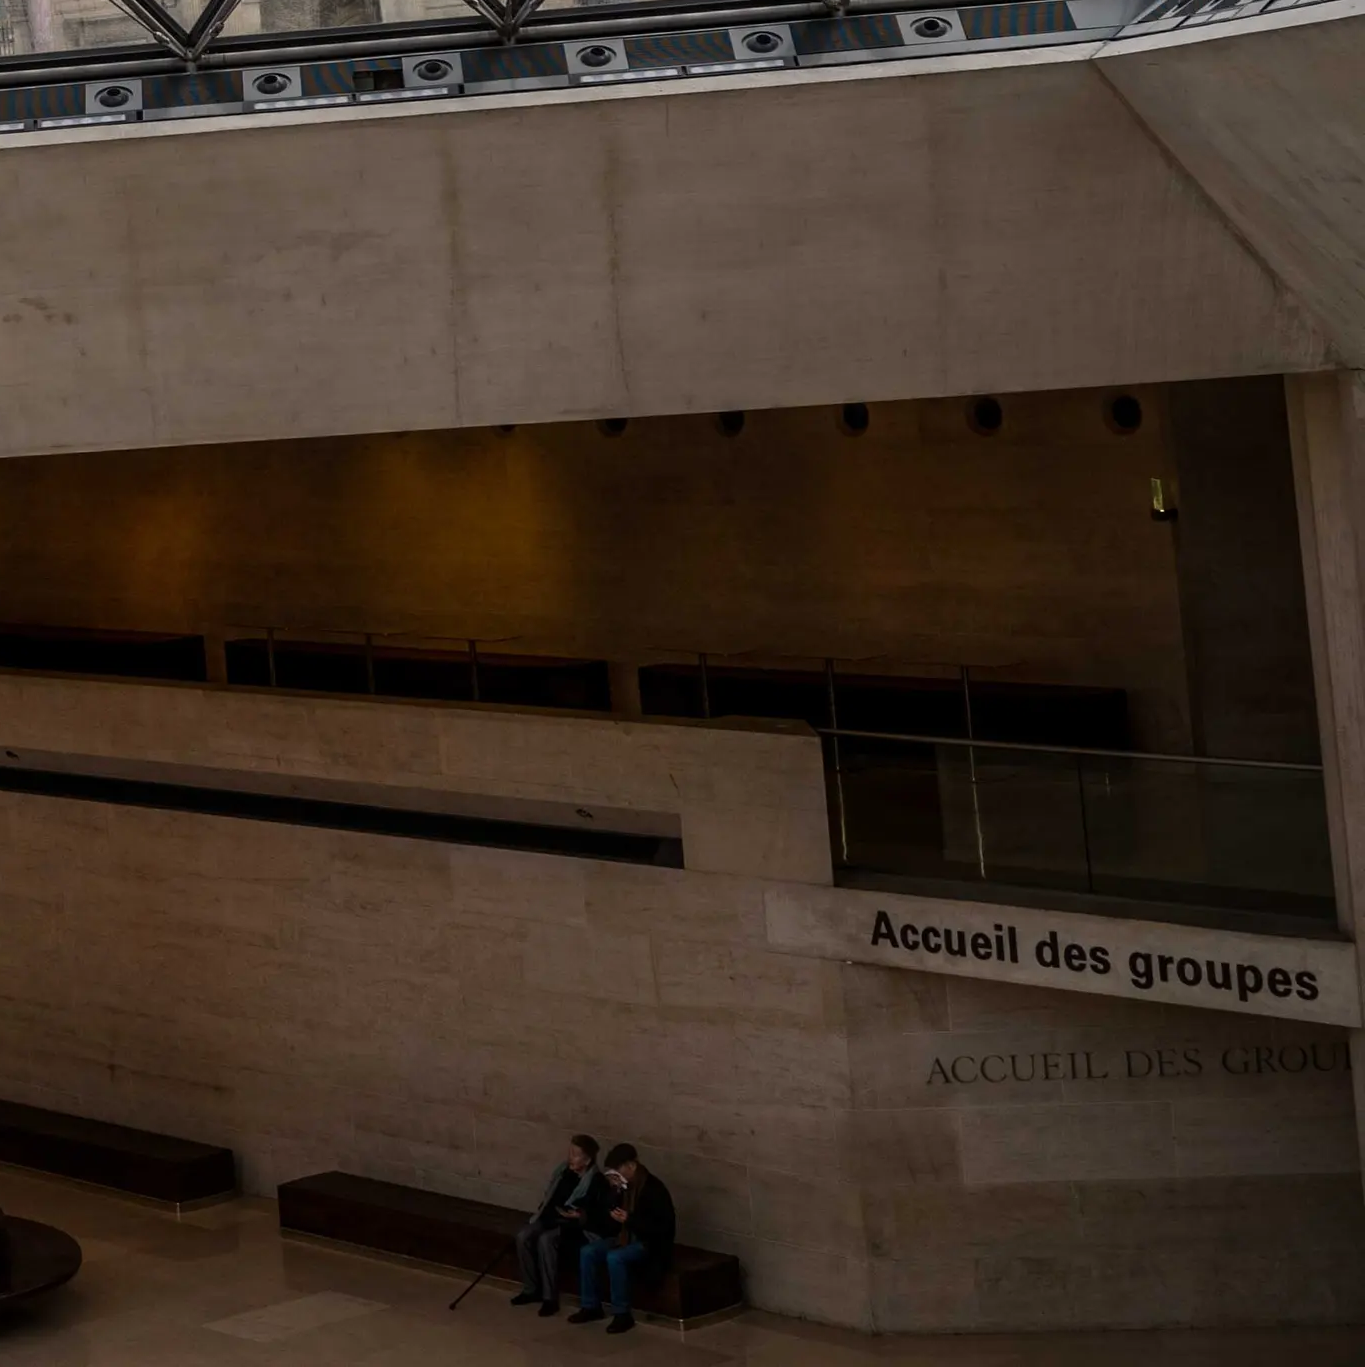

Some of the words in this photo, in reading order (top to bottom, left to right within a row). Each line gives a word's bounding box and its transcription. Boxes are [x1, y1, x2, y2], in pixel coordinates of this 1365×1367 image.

[871, 909, 1019, 964] Accueil
[1035, 931, 1111, 975] des
[1129, 950, 1319, 1003] groupes
[925, 1050, 1110, 1086] ACCUEIL
[1124, 1047, 1205, 1080] DES
[1221, 1039, 1353, 1075] GROU
